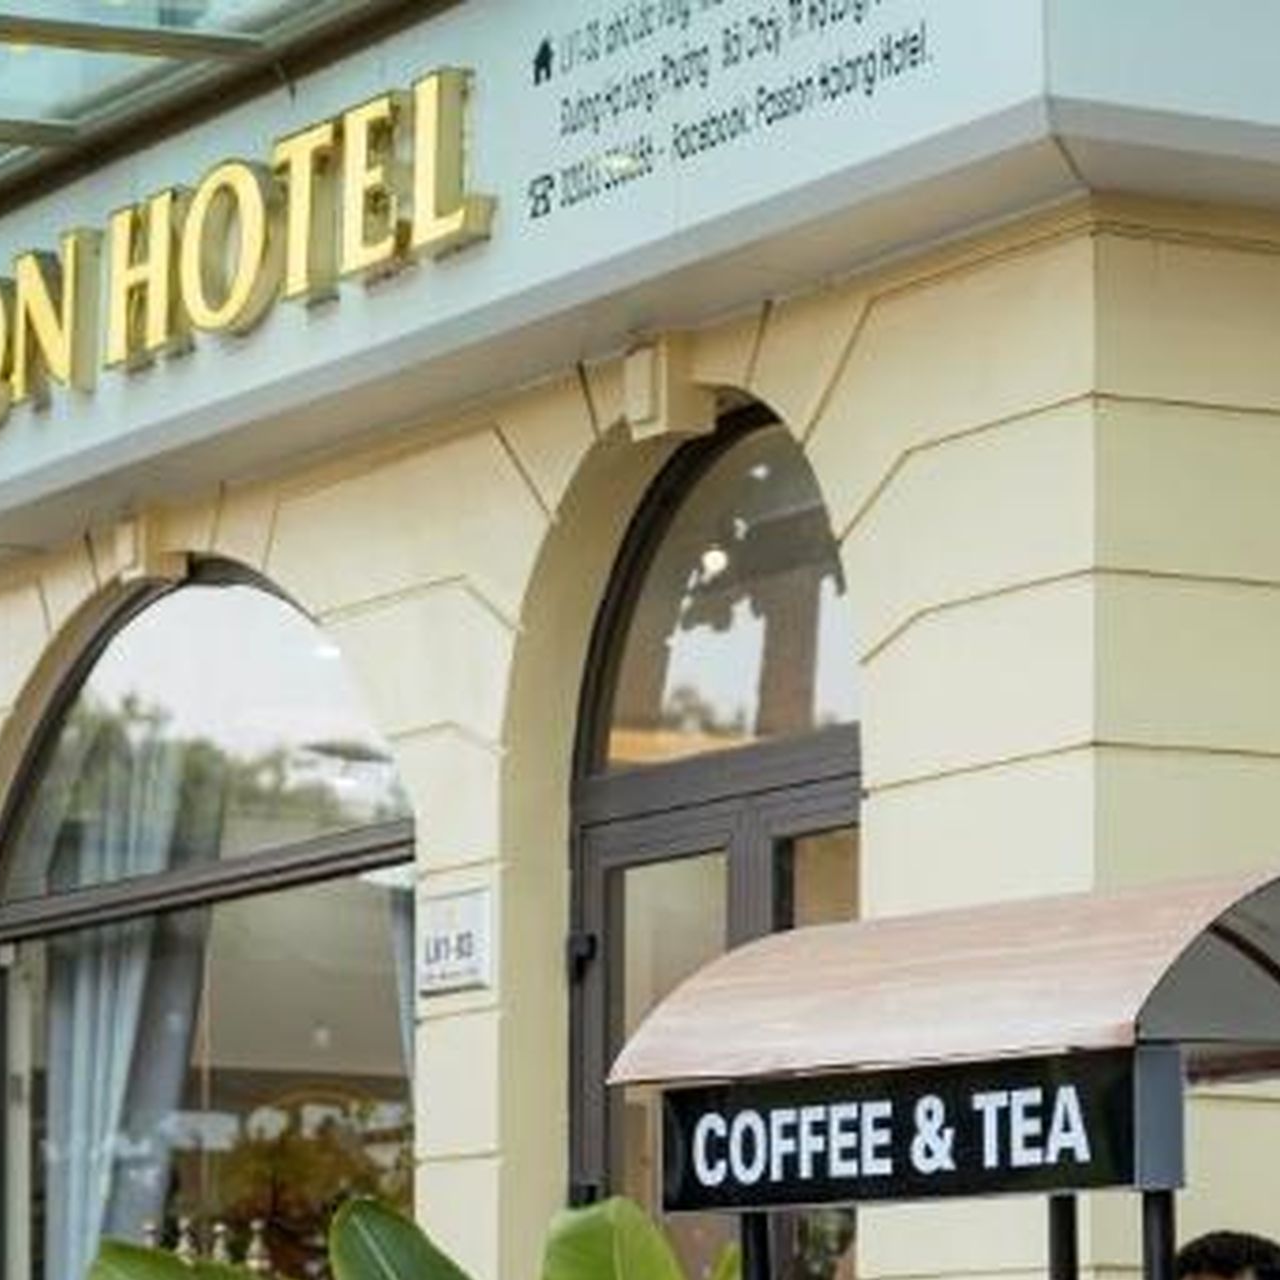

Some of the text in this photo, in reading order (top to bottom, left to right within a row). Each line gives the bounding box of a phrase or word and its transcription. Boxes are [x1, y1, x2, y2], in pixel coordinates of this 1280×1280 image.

[106, 68, 490, 370] HOTEL
[692, 1085, 1091, 1187] COFFEE & TEA
